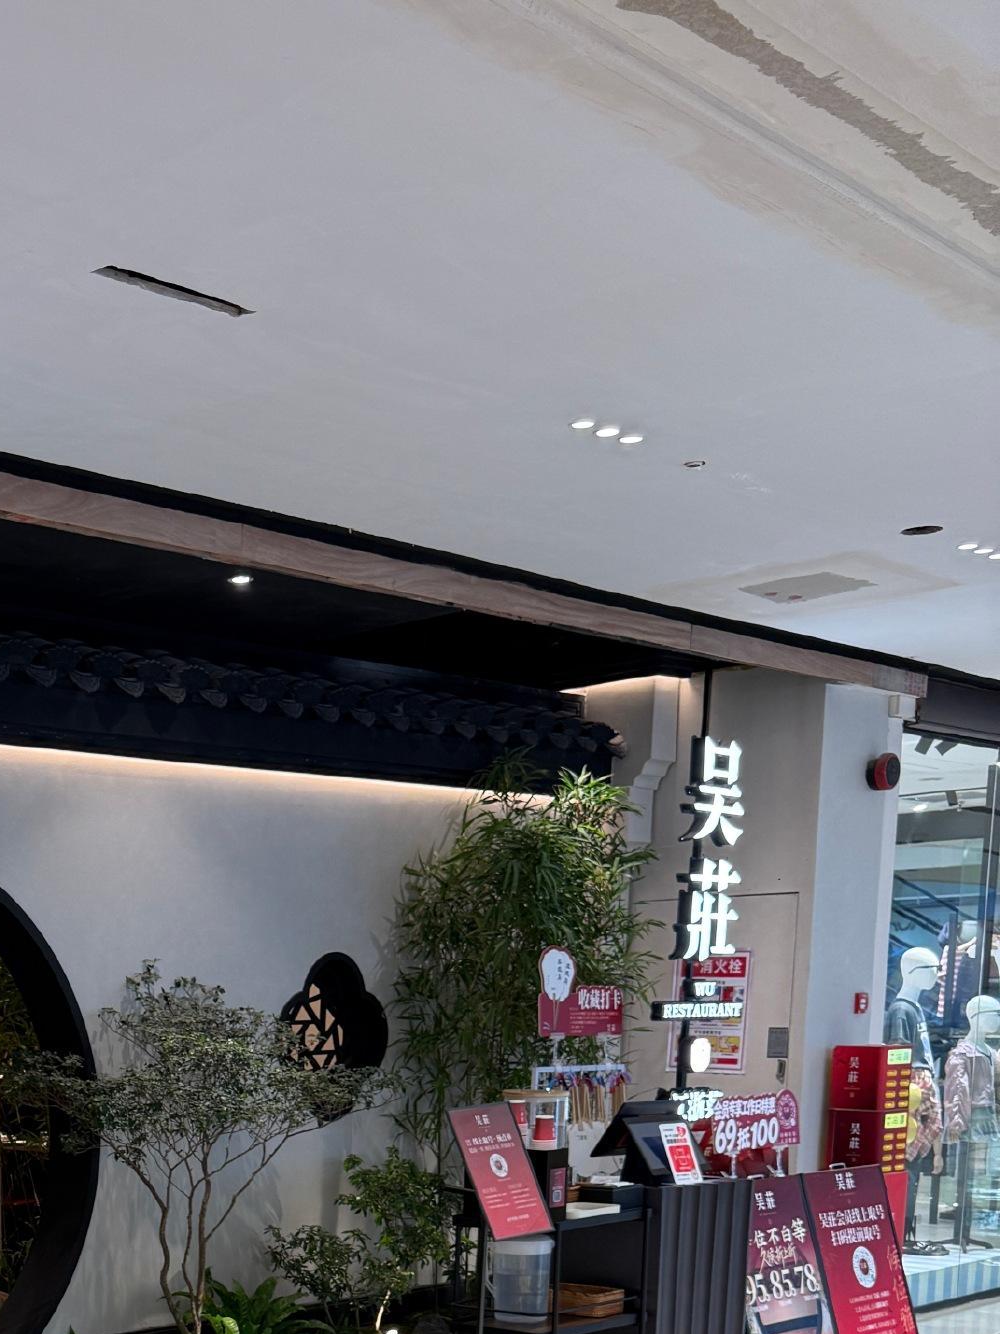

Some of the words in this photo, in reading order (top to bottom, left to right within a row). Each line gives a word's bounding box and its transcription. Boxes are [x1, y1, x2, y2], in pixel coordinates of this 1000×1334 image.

[694, 959, 743, 974] 消火栓
[578, 988, 621, 1010] 收藏打卡
[694, 982, 717, 997] WU
[663, 1002, 743, 1018] RESTAURANT
[714, 1096, 777, 1120] 会员专享工作日特惠
[714, 1117, 779, 1154] 69抵100
[749, 1217, 806, 1249] 位不白等
